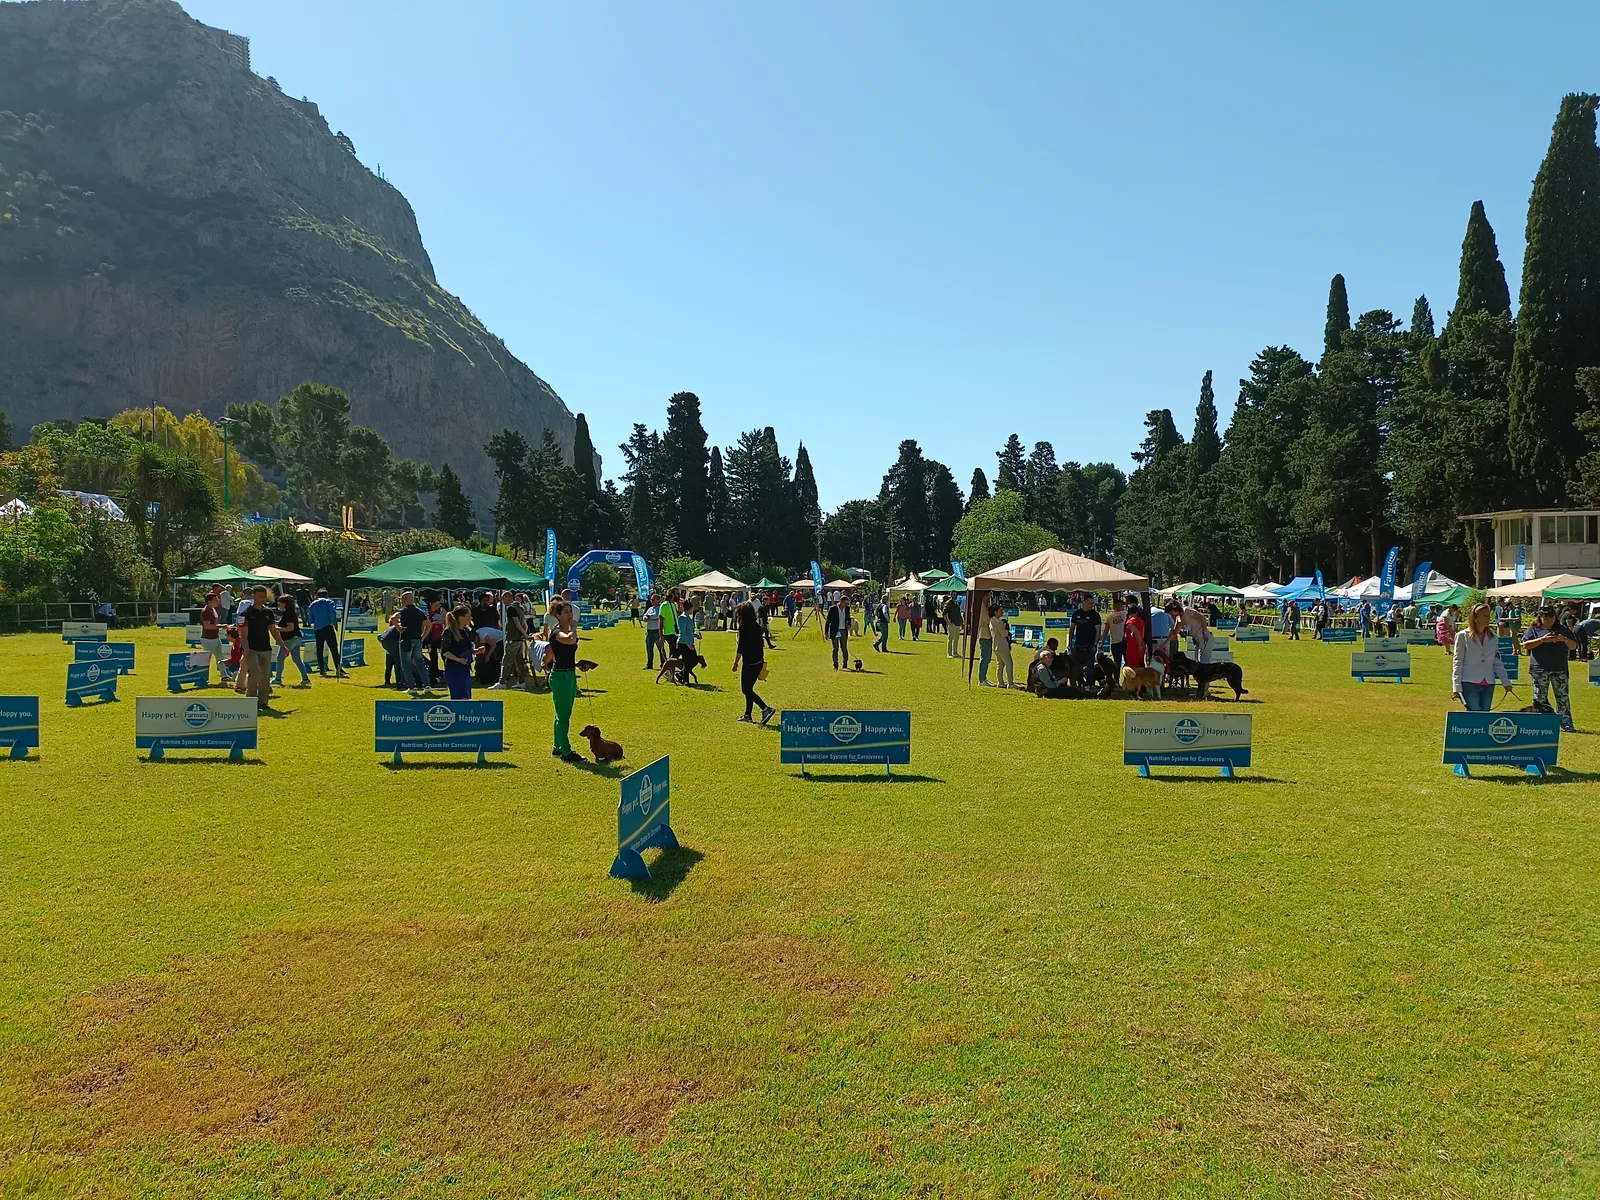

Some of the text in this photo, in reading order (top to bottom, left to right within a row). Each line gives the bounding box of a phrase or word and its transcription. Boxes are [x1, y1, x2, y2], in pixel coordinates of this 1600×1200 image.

[1384, 551, 1395, 587] Farmina
[214, 712, 236, 720] Happy
[382, 714, 420, 723] Happy pet.
[426, 714, 452, 722] Farmina
[459, 715, 480, 723] Happy
[787, 725, 810, 734] Happy
[865, 726, 887, 734] Happy
[1131, 726, 1152, 734] Happy
[1174, 726, 1200, 734] Farmina
[1206, 728, 1228, 736] Happy
[1451, 726, 1472, 734] Happy
[1520, 728, 1540, 736] Happy
